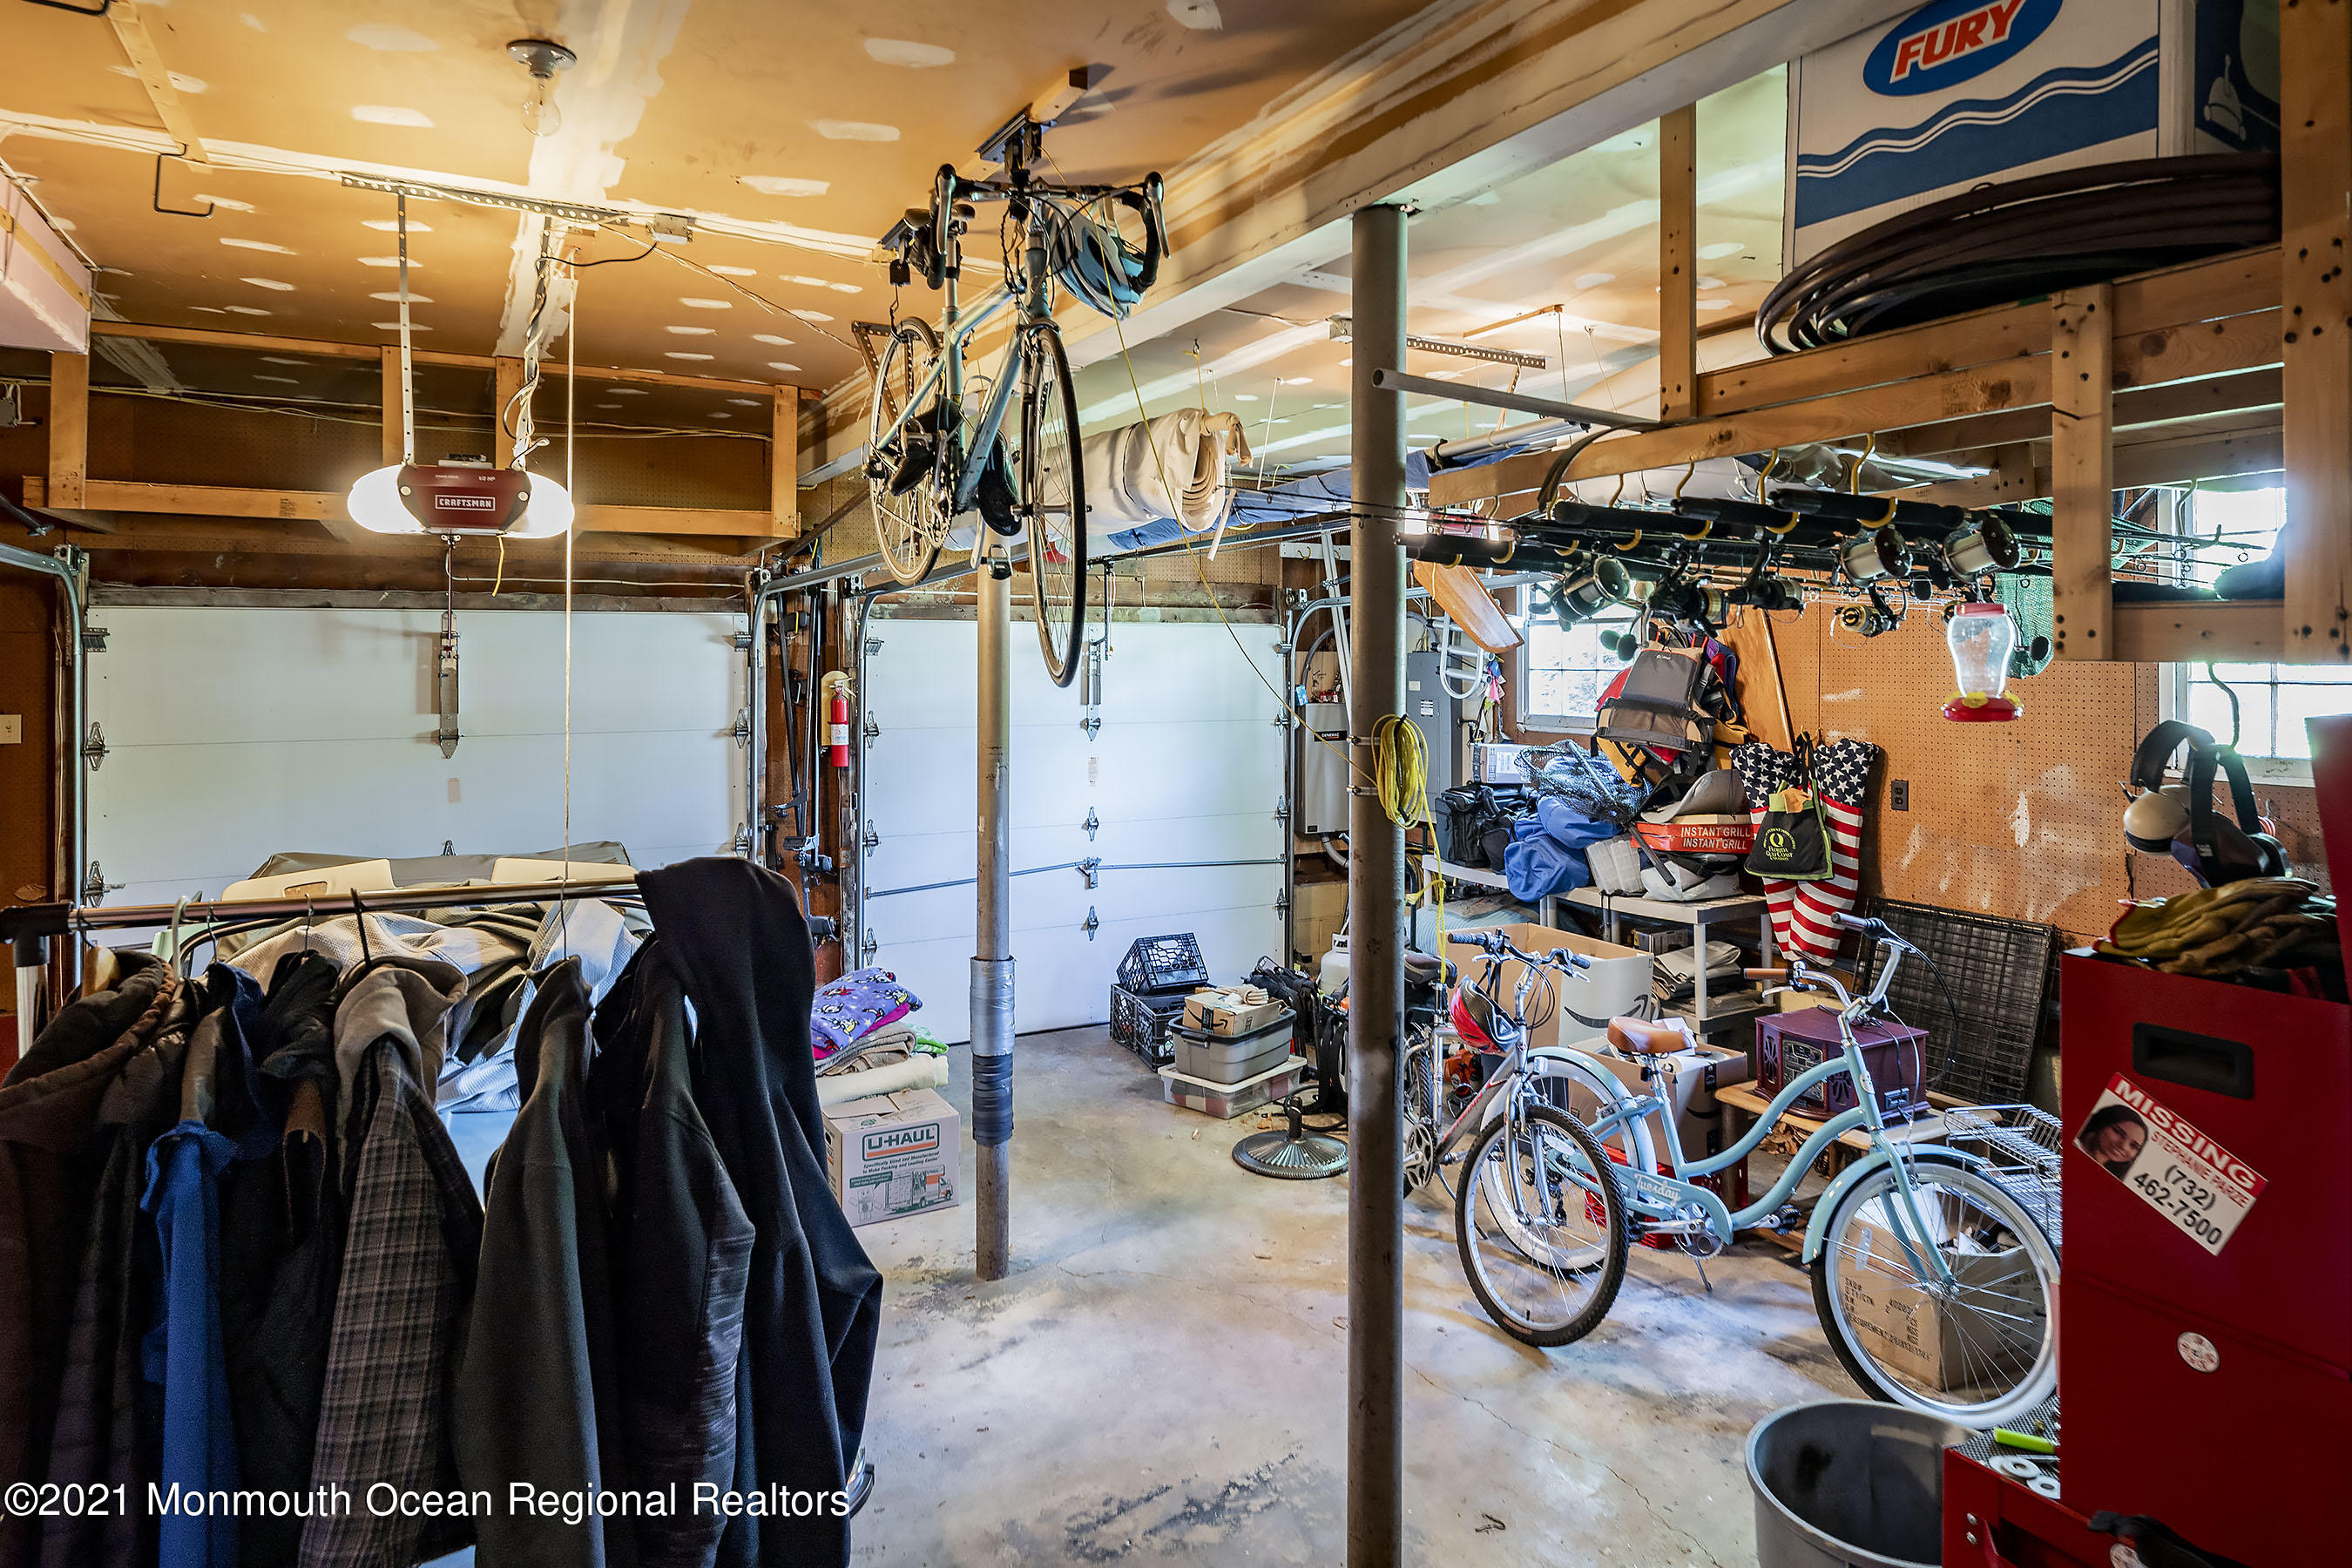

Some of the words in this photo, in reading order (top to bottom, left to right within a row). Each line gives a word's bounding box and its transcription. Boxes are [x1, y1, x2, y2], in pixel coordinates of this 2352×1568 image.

[1892, 0, 2021, 82] FURY
[439, 498, 491, 508] CRAFTSMAN
[1681, 827, 1721, 837] INSTANT
[1723, 827, 1750, 837] GRILL
[1683, 837, 1721, 849] INSTANT
[1722, 840, 1747, 850] GRILL
[868, 1128, 935, 1150] U-HAUL
[2114, 1079, 2257, 1191] MISSING
[1634, 1173, 1680, 1206] Tuesday
[2150, 1131, 2212, 1181] STEPHANIE
[2210, 1173, 2250, 1209] PARZE
[2164, 1164, 2216, 1212] (732)
[2133, 1173, 2223, 1246] 462-7500
